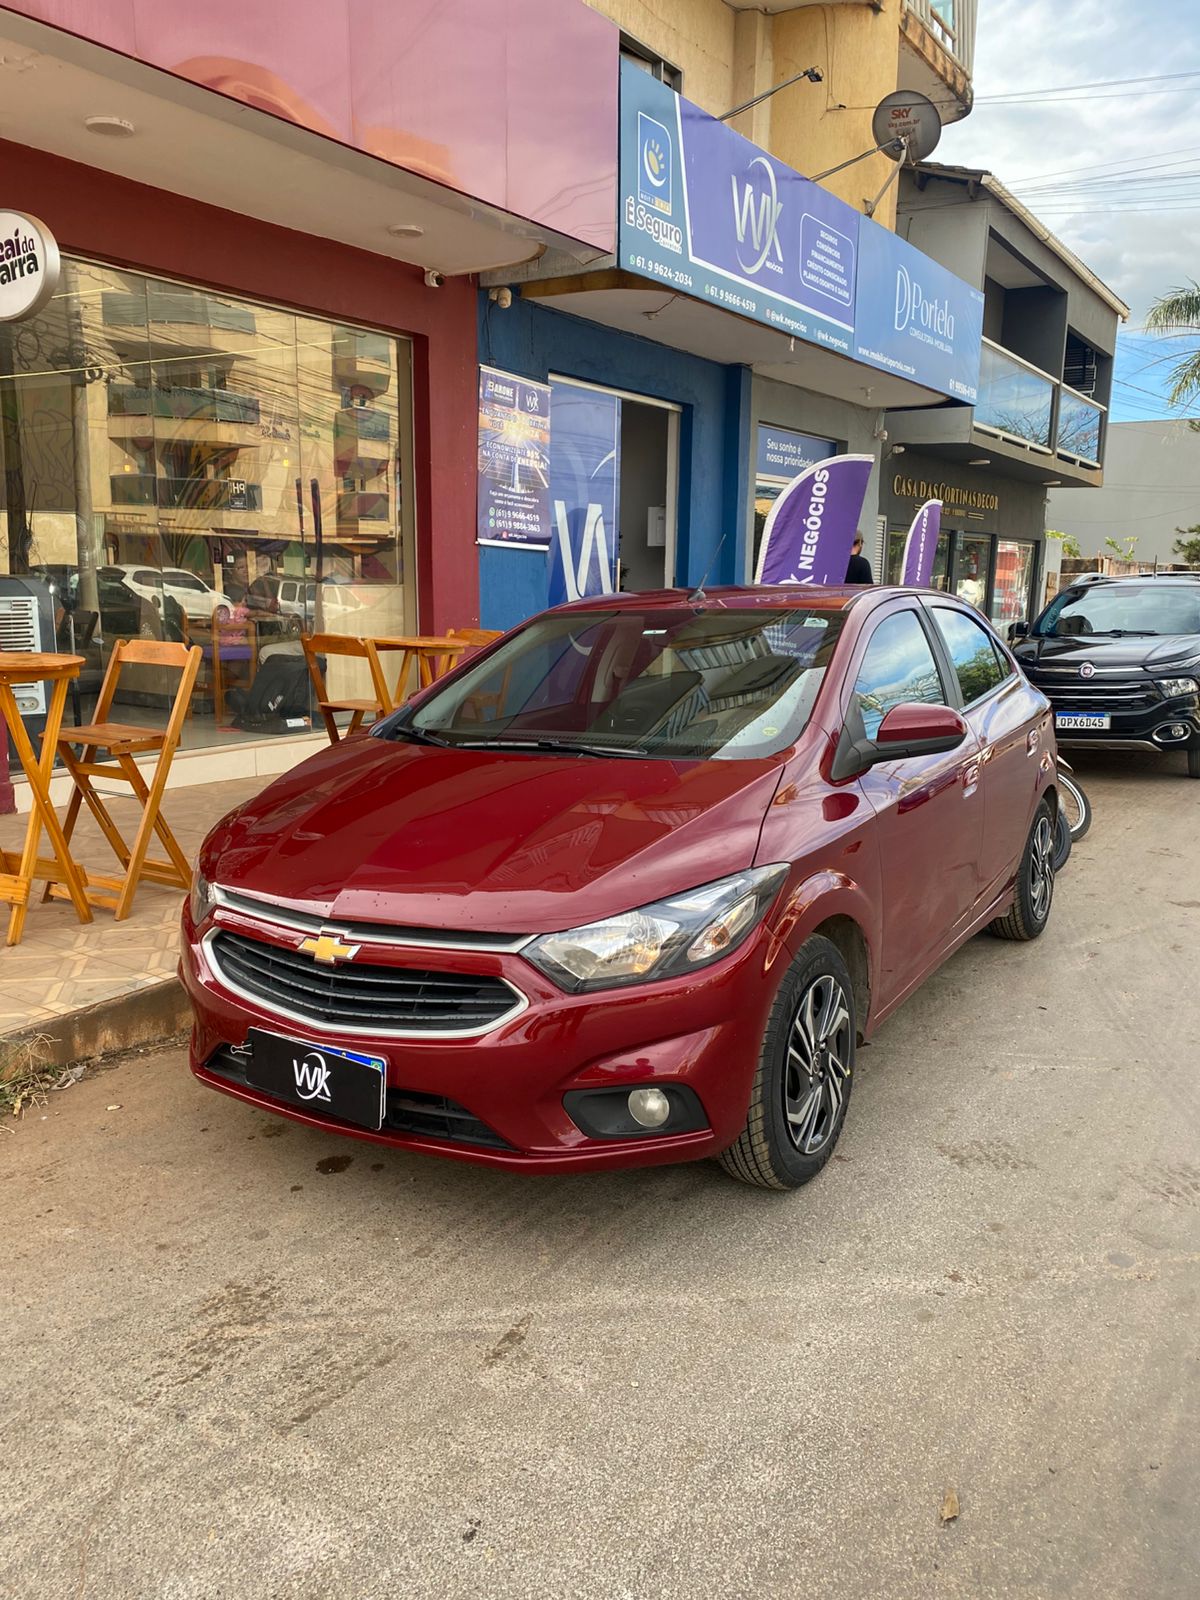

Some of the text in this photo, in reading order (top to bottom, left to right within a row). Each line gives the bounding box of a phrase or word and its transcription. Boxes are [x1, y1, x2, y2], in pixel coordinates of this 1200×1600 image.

[891, 107, 912, 120] SKY
[626, 196, 635, 226] É
[636, 205, 682, 244] Seguro
[22, 235, 35, 254] da
[636, 256, 693, 288] 61. 9 9624-2034
[710, 285, 757, 312] 61. 9 9666-4519
[911, 282, 955, 340] Portela
[766, 438, 779, 450] Seu
[779, 443, 797, 454] sonho
[766, 453, 784, 464] nossa
[893, 474, 999, 510] CASA DAS CORTINAS DECOR
[797, 469, 830, 571] NEGÓCIOS
